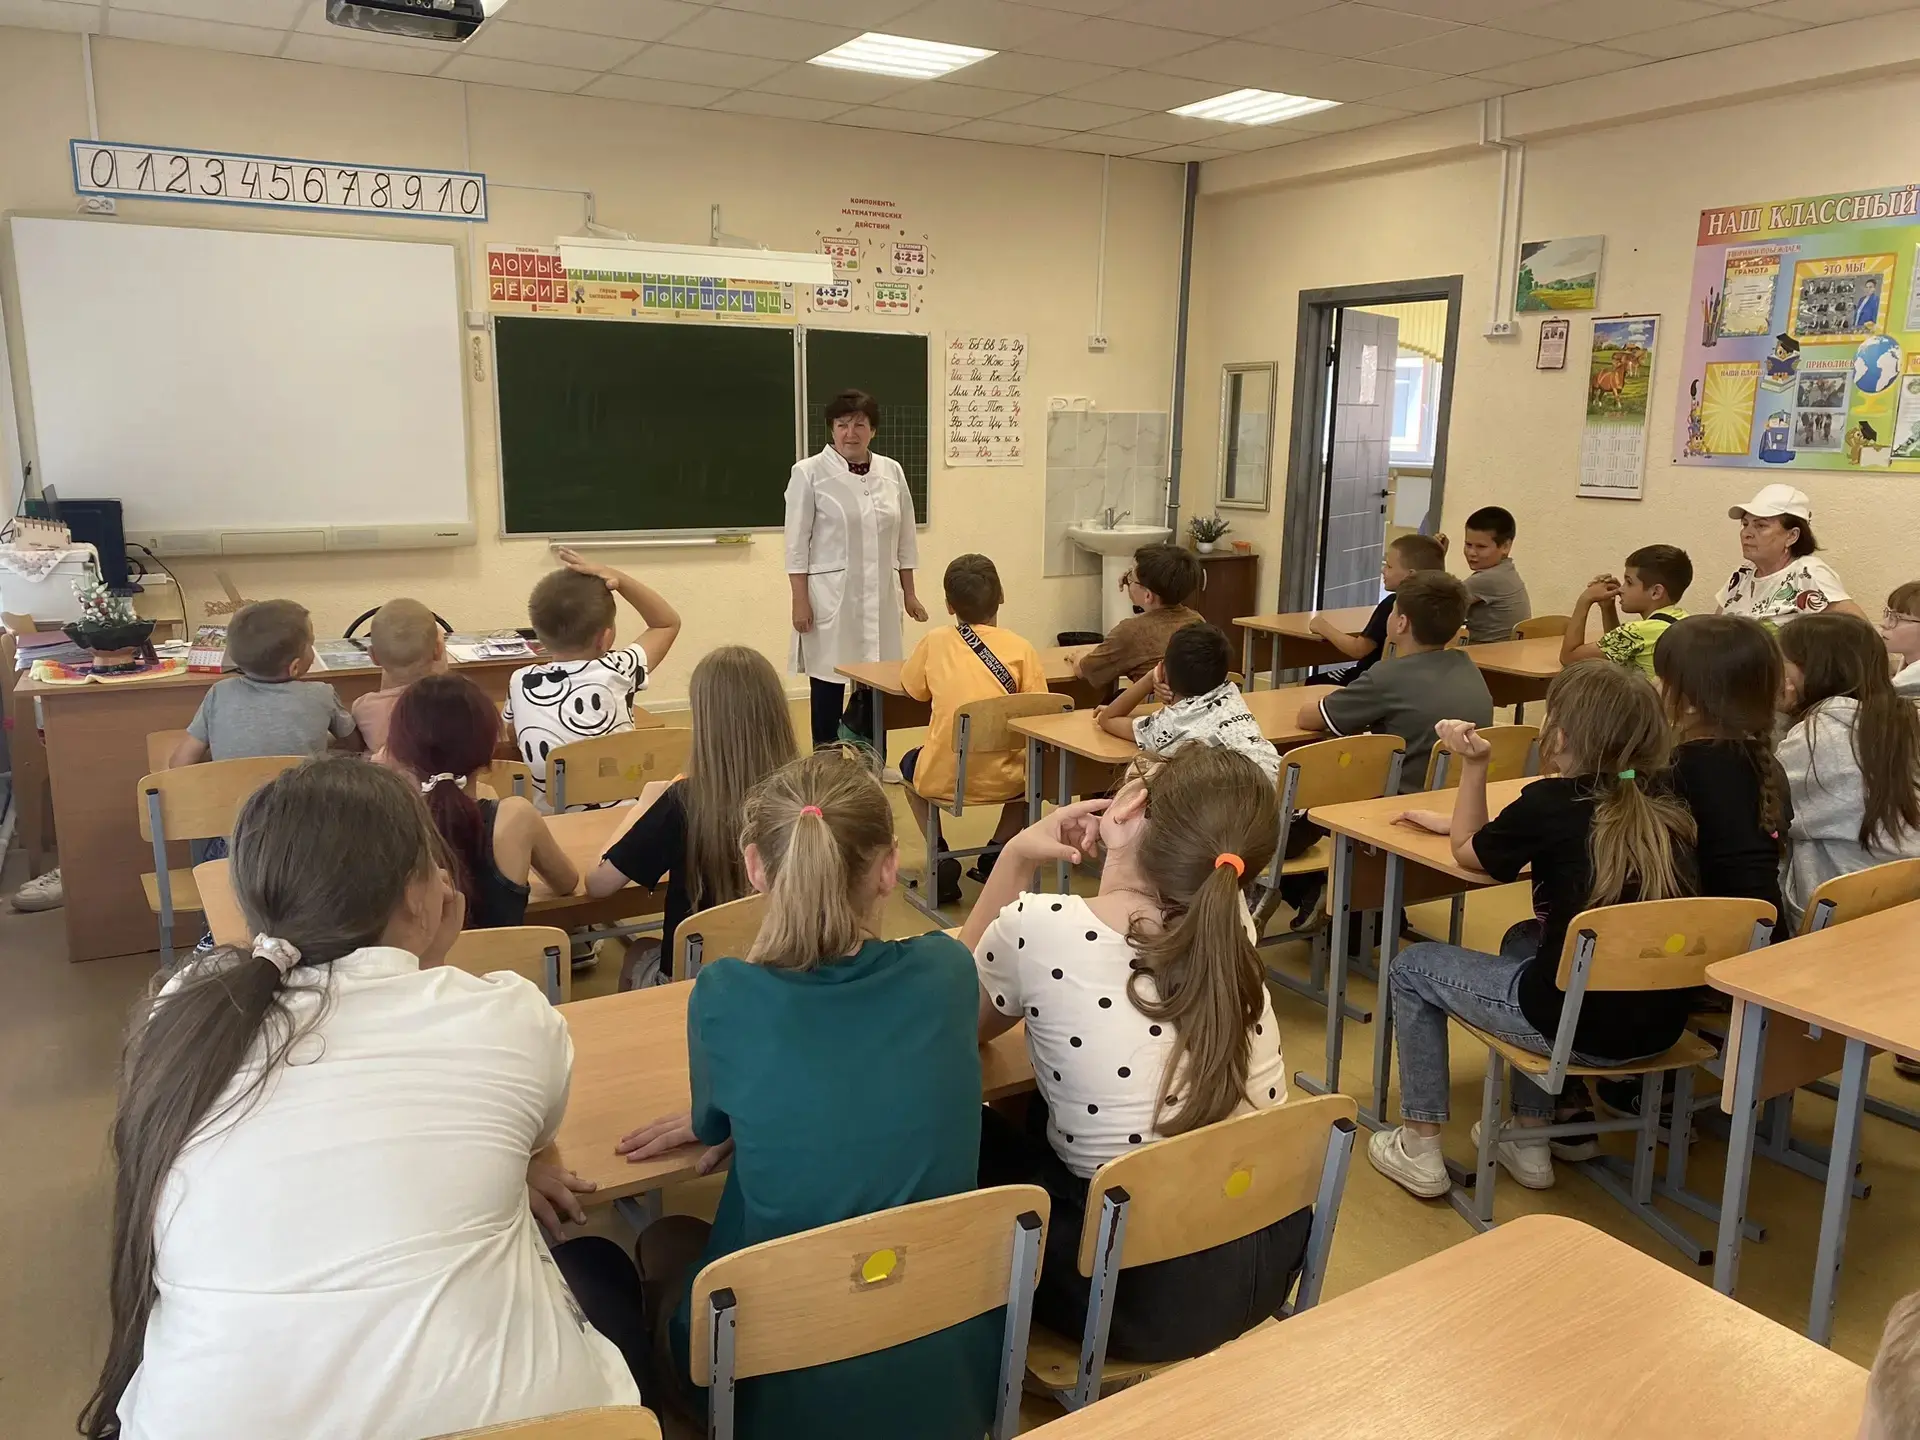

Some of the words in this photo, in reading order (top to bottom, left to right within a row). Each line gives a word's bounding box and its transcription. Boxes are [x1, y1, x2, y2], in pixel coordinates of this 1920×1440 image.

[91, 149, 114, 188] 0
[136, 153, 151, 190] 1
[165, 155, 189, 193] 2
[200, 158, 224, 195] 3
[241, 162, 259, 198] 4
[268, 164, 292, 200] 5
[303, 167, 326, 203] 6
[337, 169, 358, 205] 7
[370, 172, 390, 207] 8
[402, 175, 421, 209] 9
[438, 177, 480, 214] 10
[850, 197, 896, 207] КОМПОНЕНТЫ
[1707, 207, 1762, 236] НАШ
[1767, 184, 1920, 231] КЛАССНЫЙ
[841, 208, 903, 219] МАТЕМАТИЧЕСКИХ
[491, 258, 502, 271] А
[506, 259, 518, 271] О
[523, 260, 533, 272] У
[538, 261, 550, 273] Ы
[554, 261, 564, 274] Э
[1734, 267, 1769, 275] ГРАМОТА
[1823, 265, 1841, 275] ЭТО
[1845, 262, 1866, 273] МЫ!
[493, 282, 503, 295] Я
[509, 281, 518, 296] Ё
[523, 284, 536, 297] Ю
[540, 285, 550, 297] И
[556, 285, 565, 298] Е
[646, 290, 654, 302] П
[660, 291, 669, 302] Ф
[674, 291, 683, 304] К
[688, 292, 697, 304] Т
[701, 293, 712, 305] Ш
[715, 294, 724, 306] С
[730, 295, 739, 307] Х
[743, 294, 753, 308] Ц
[757, 296, 766, 307] Ч
[769, 295, 780, 309] Щ
[783, 298, 792, 310] Ь
